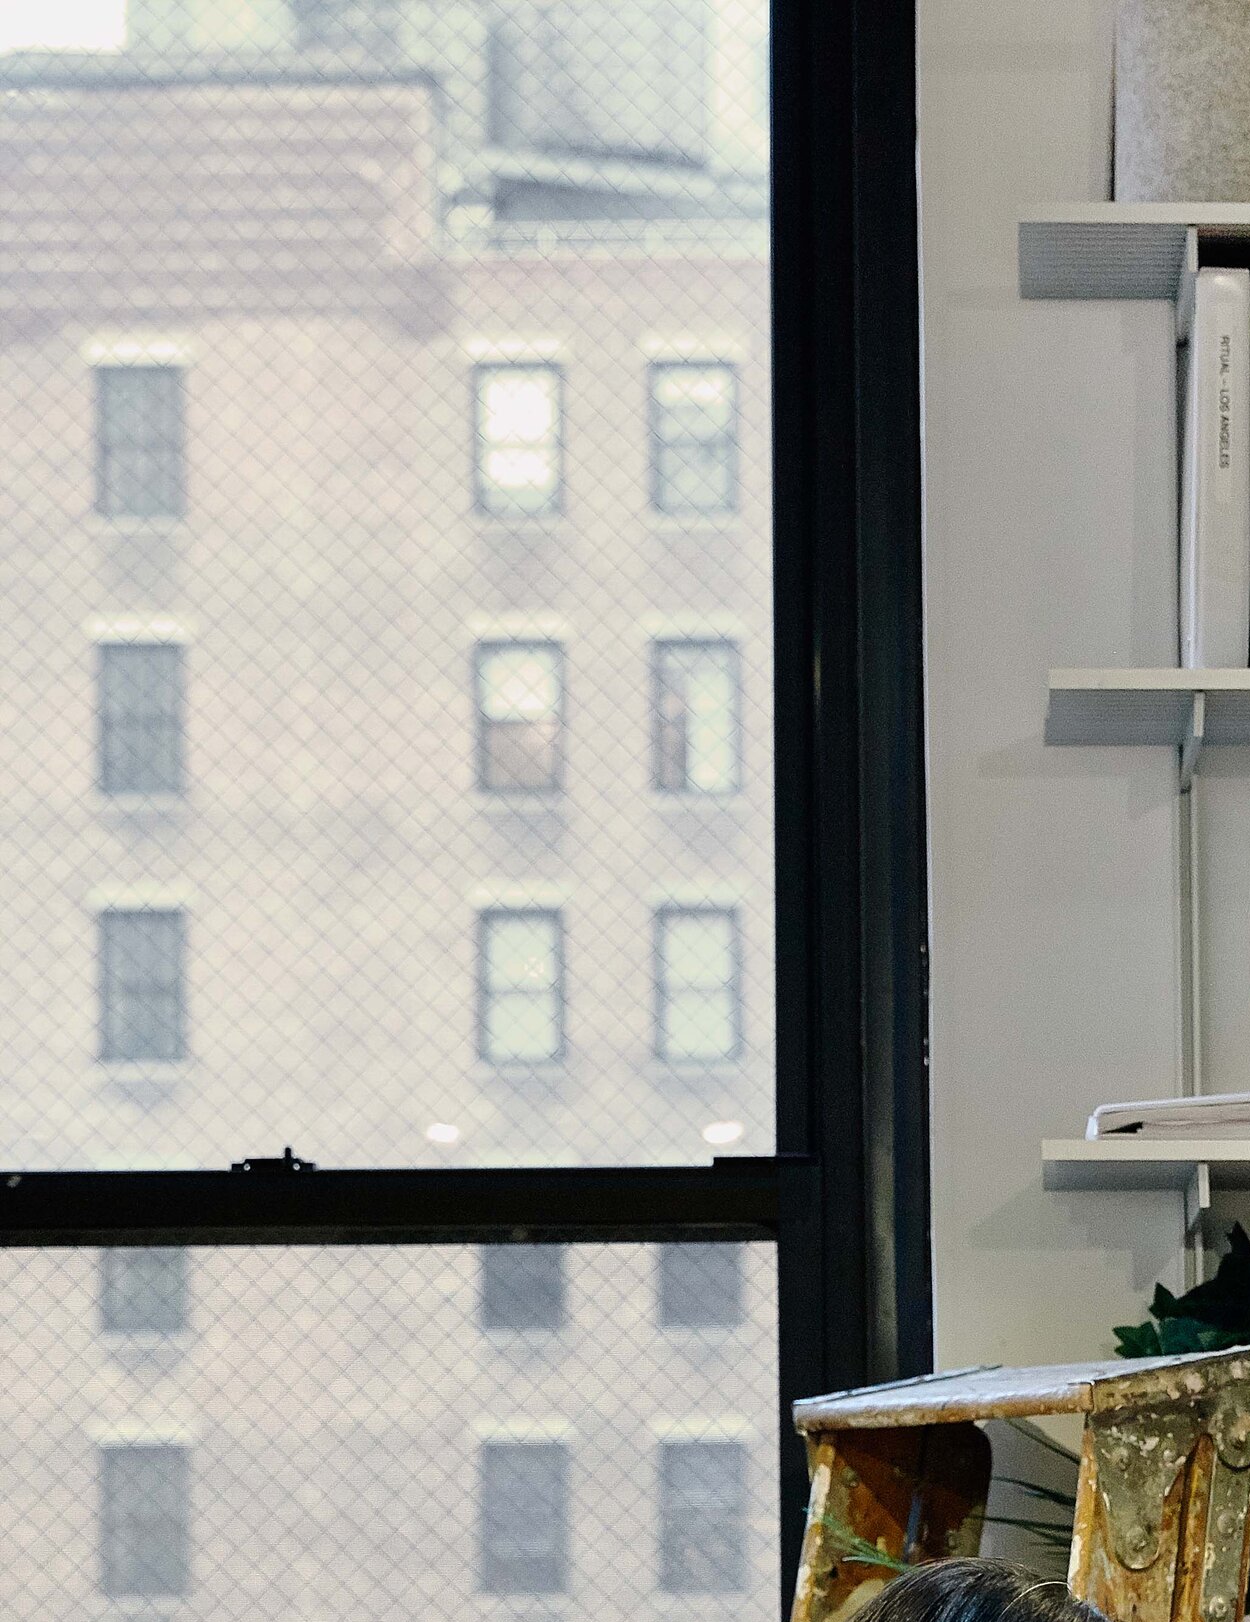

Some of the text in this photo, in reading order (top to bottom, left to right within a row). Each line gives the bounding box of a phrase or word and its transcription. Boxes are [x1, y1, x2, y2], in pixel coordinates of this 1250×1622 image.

[1219, 335, 1231, 375] RITUAL
[1219, 388, 1231, 412] LOS
[1219, 415, 1231, 470] ANGELES
